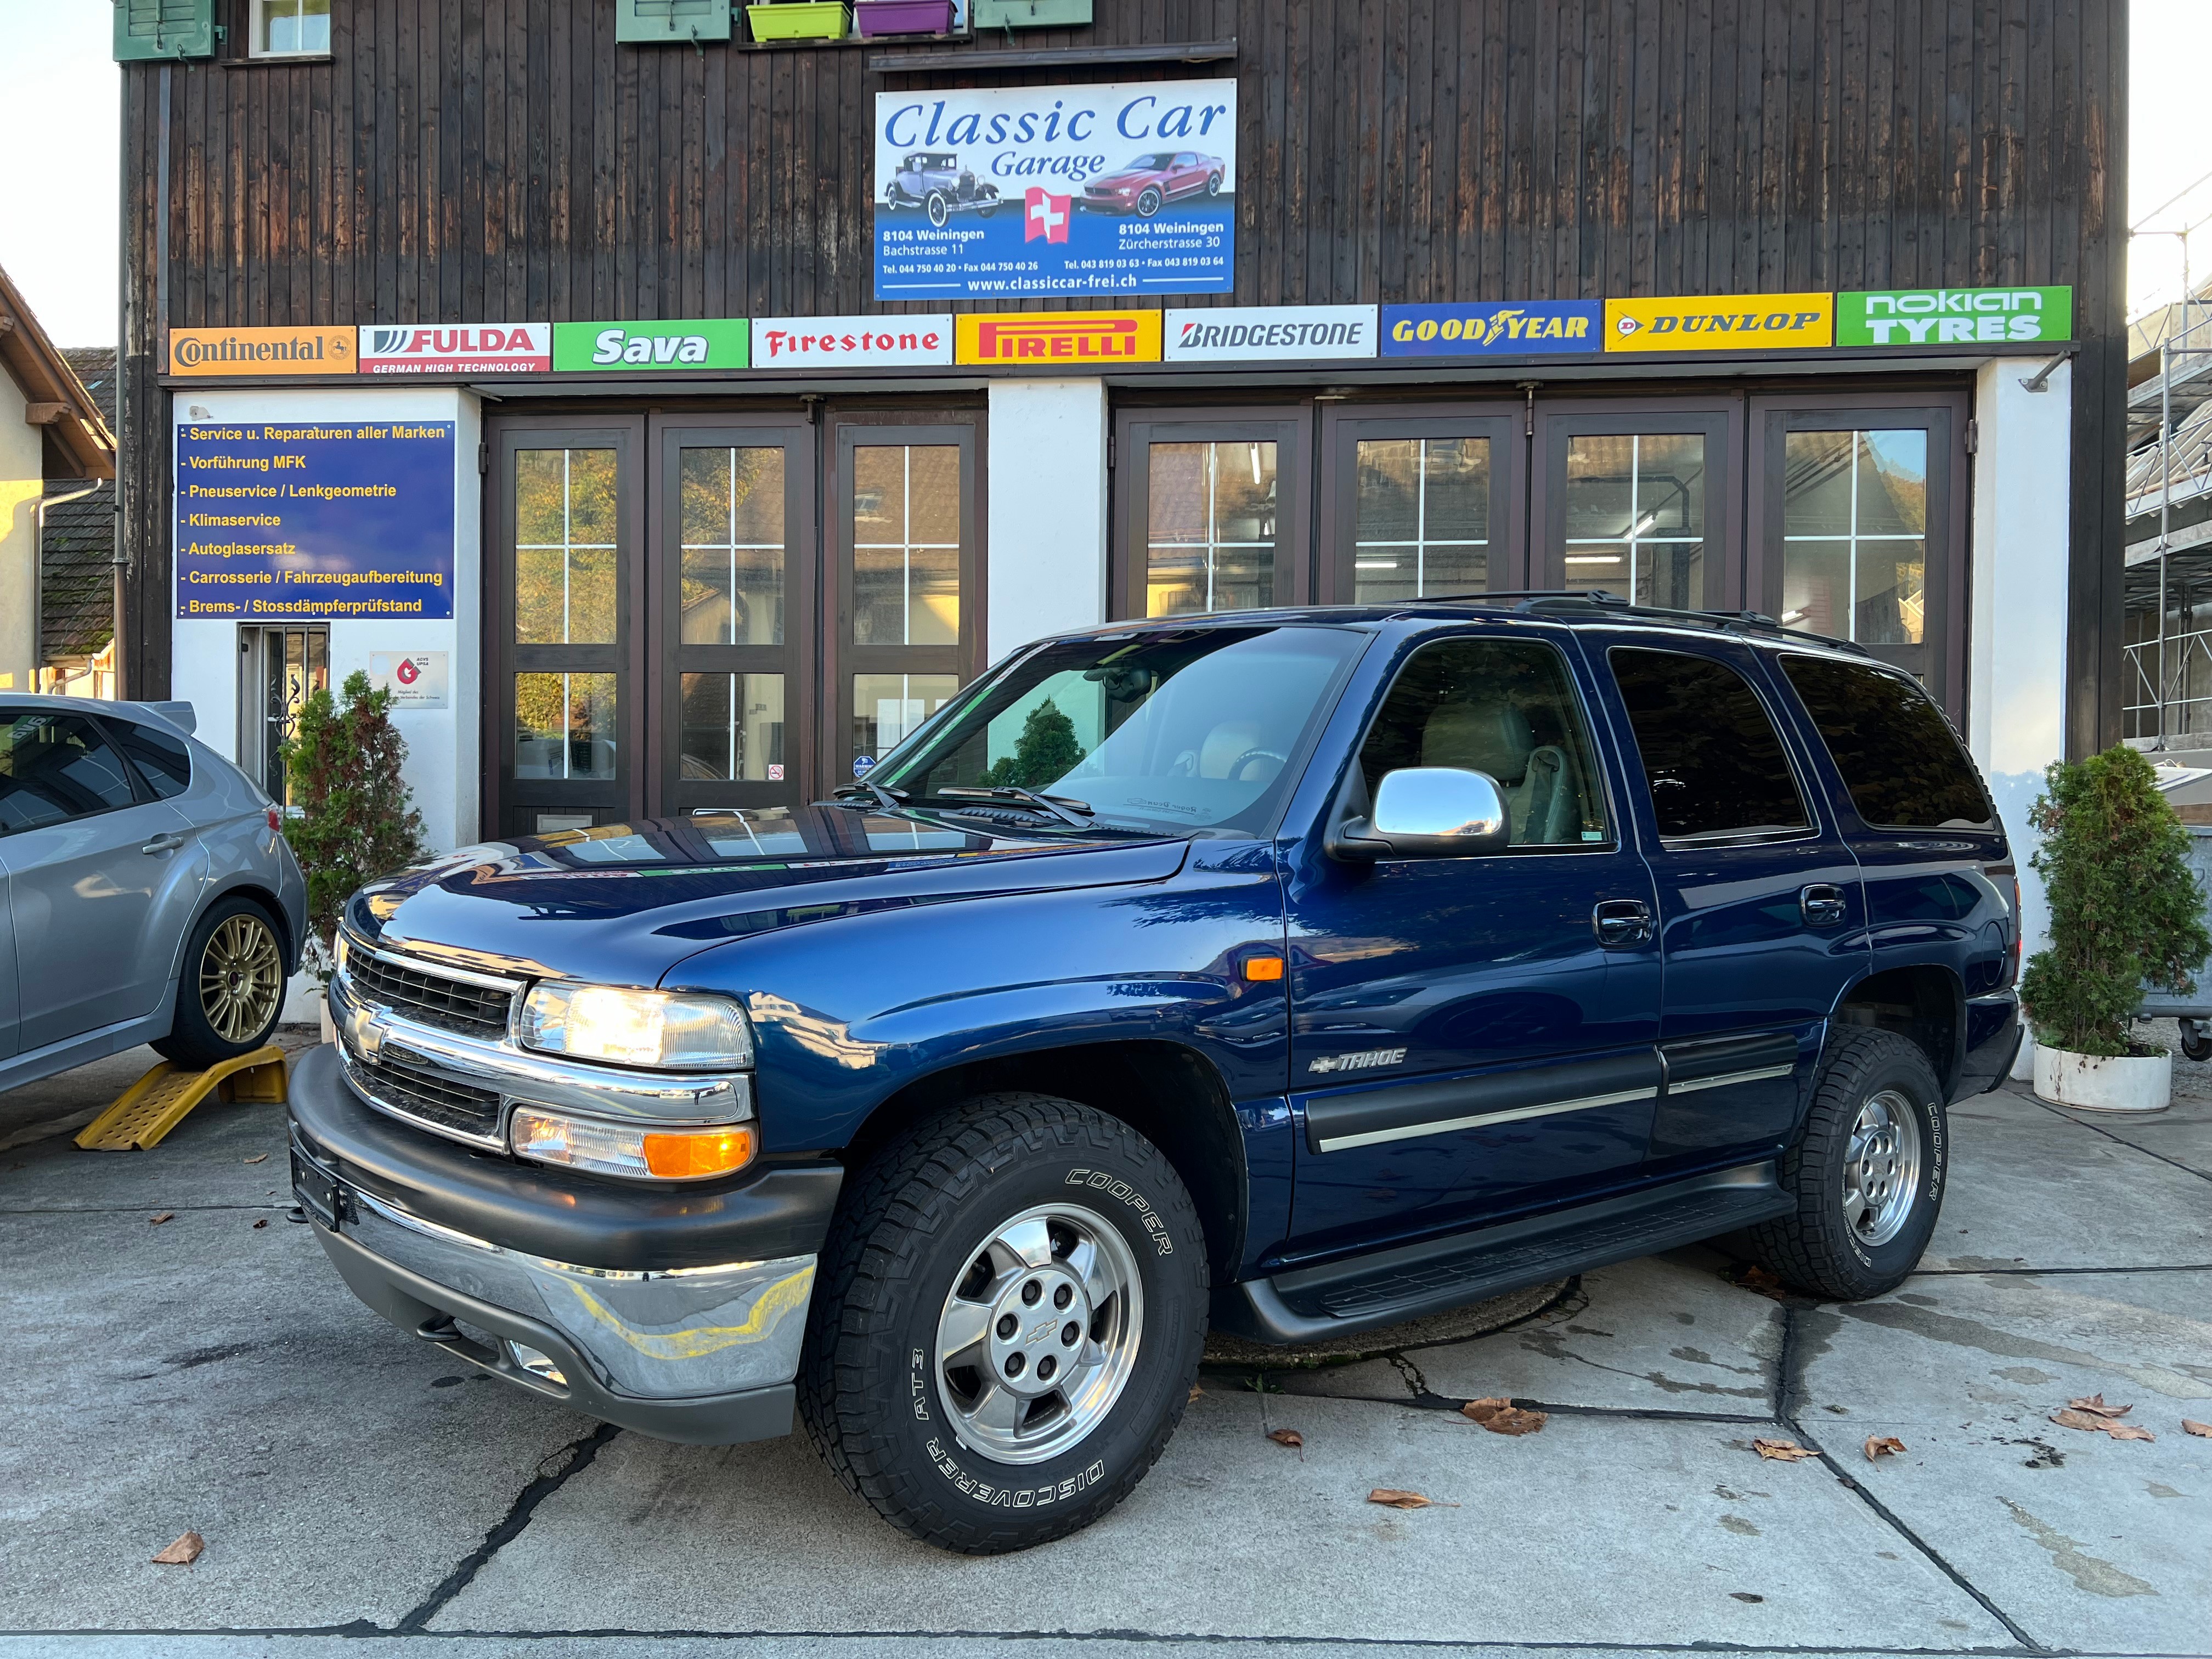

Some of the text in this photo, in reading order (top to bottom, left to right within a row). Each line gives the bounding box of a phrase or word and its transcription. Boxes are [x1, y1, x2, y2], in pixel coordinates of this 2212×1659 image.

[885, 96, 1226, 147] Classic Car
[991, 150, 1105, 182] Garage
[883, 228, 984, 242] 8104 Weiningen
[1119, 222, 1223, 235] 8104 Weiningen
[883, 244, 963, 256] Bachstrasse 11
[1119, 236, 1220, 250] Zürcherstrasse 30
[883, 261, 1038, 274] Tel. 044 750 40 20 Fax 044 750 40 26
[1064, 256, 1223, 269] Tel. 043 819 03 63 Fax 043 819 03 64
[968, 273, 1137, 291] www.classiccar-frei.ch
[1648, 312, 1821, 334] DUNLOP
[1865, 315, 2041, 343] TYRES
[400, 329, 535, 353] FULDA
[765, 330, 940, 357] Firestone
[979, 320, 1138, 358] PIRELLI
[1178, 323, 1364, 349] BRIDGESTONE
[174, 336, 324, 367] Continental
[592, 329, 710, 365] Sava
[373, 363, 535, 373] GERMAN HIGH TECHNOLOGY
[191, 428, 242, 440] Service
[247, 430, 259, 439] u.
[265, 427, 352, 442] Reparaturen
[357, 427, 387, 438] aller
[393, 426, 444, 438] Marken
[190, 456, 269, 471] Vorführung
[274, 456, 305, 468] MFK
[190, 485, 276, 497] Pneuservice
[290, 484, 396, 499] Lenkgeometrie
[190, 514, 280, 526] Klimaservice
[189, 543, 295, 558] Autoglasersatz
[190, 571, 272, 583] Carrosserie
[285, 570, 442, 586] Fahrzeugaufbereitung
[190, 600, 240, 612] Brems-
[253, 599, 421, 614] Stossdämpferprüfstand
[1340, 1048, 1407, 1070] TAHOE
[1927, 1102, 1942, 1201] COOPER
[1064, 1168, 1173, 1256] COOPER
[912, 1348, 929, 1421] AT3
[926, 1436, 1104, 1508] DISCOVERER
